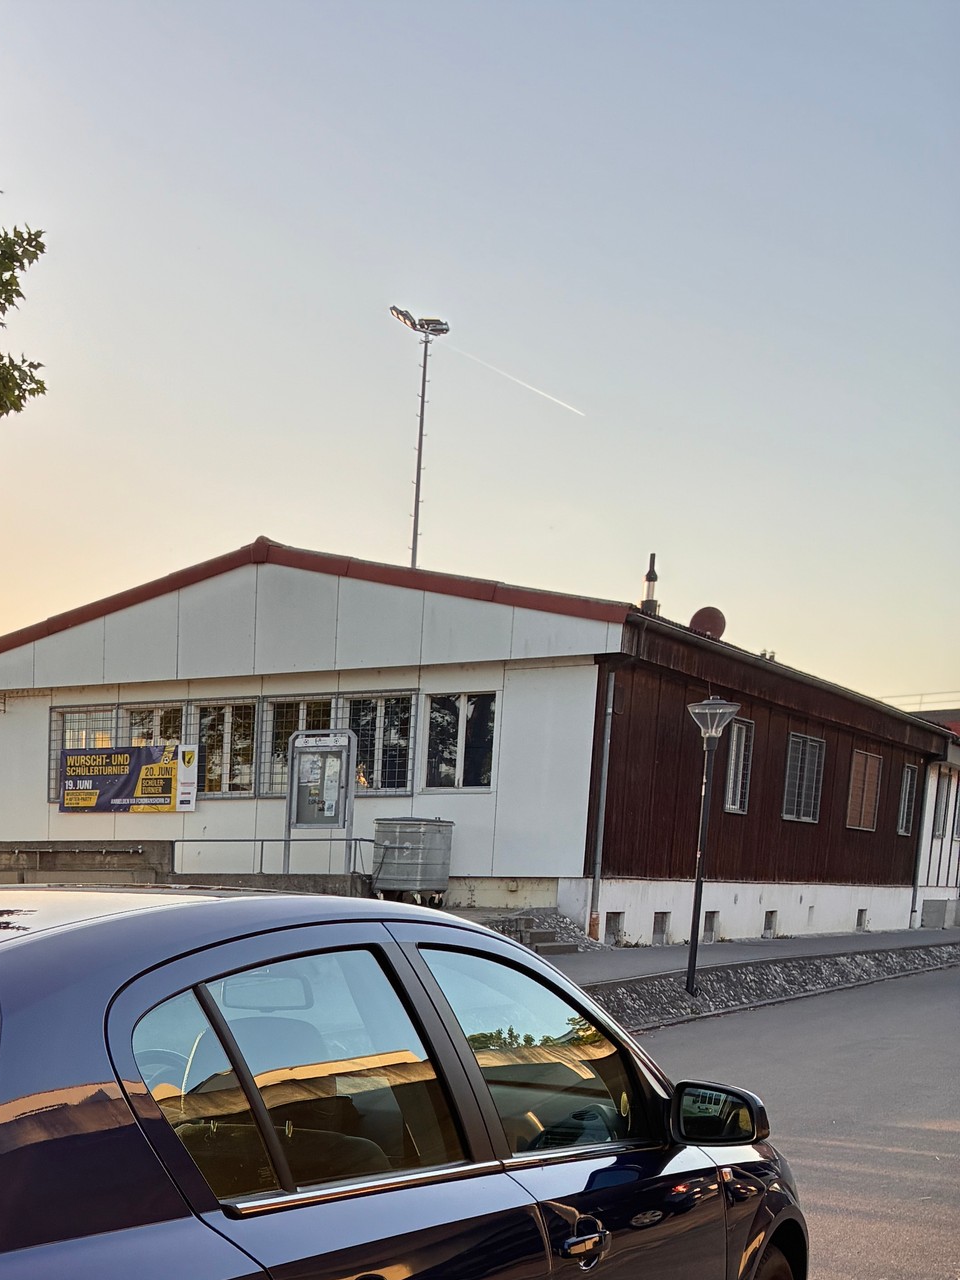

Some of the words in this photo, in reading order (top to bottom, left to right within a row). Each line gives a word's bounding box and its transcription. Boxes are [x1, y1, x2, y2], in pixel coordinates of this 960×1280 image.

[66, 753, 110, 767] WURSCHT-
[111, 753, 130, 766] UND
[66, 764, 130, 776] SCHÜLERTURNIER
[145, 767, 156, 777] 20.
[157, 767, 173, 777] JUNI
[64, 780, 76, 790] 19.
[76, 779, 93, 790] JUNI
[142, 778, 165, 787] SCHÜLER-
[142, 786, 162, 794] TURNIER
